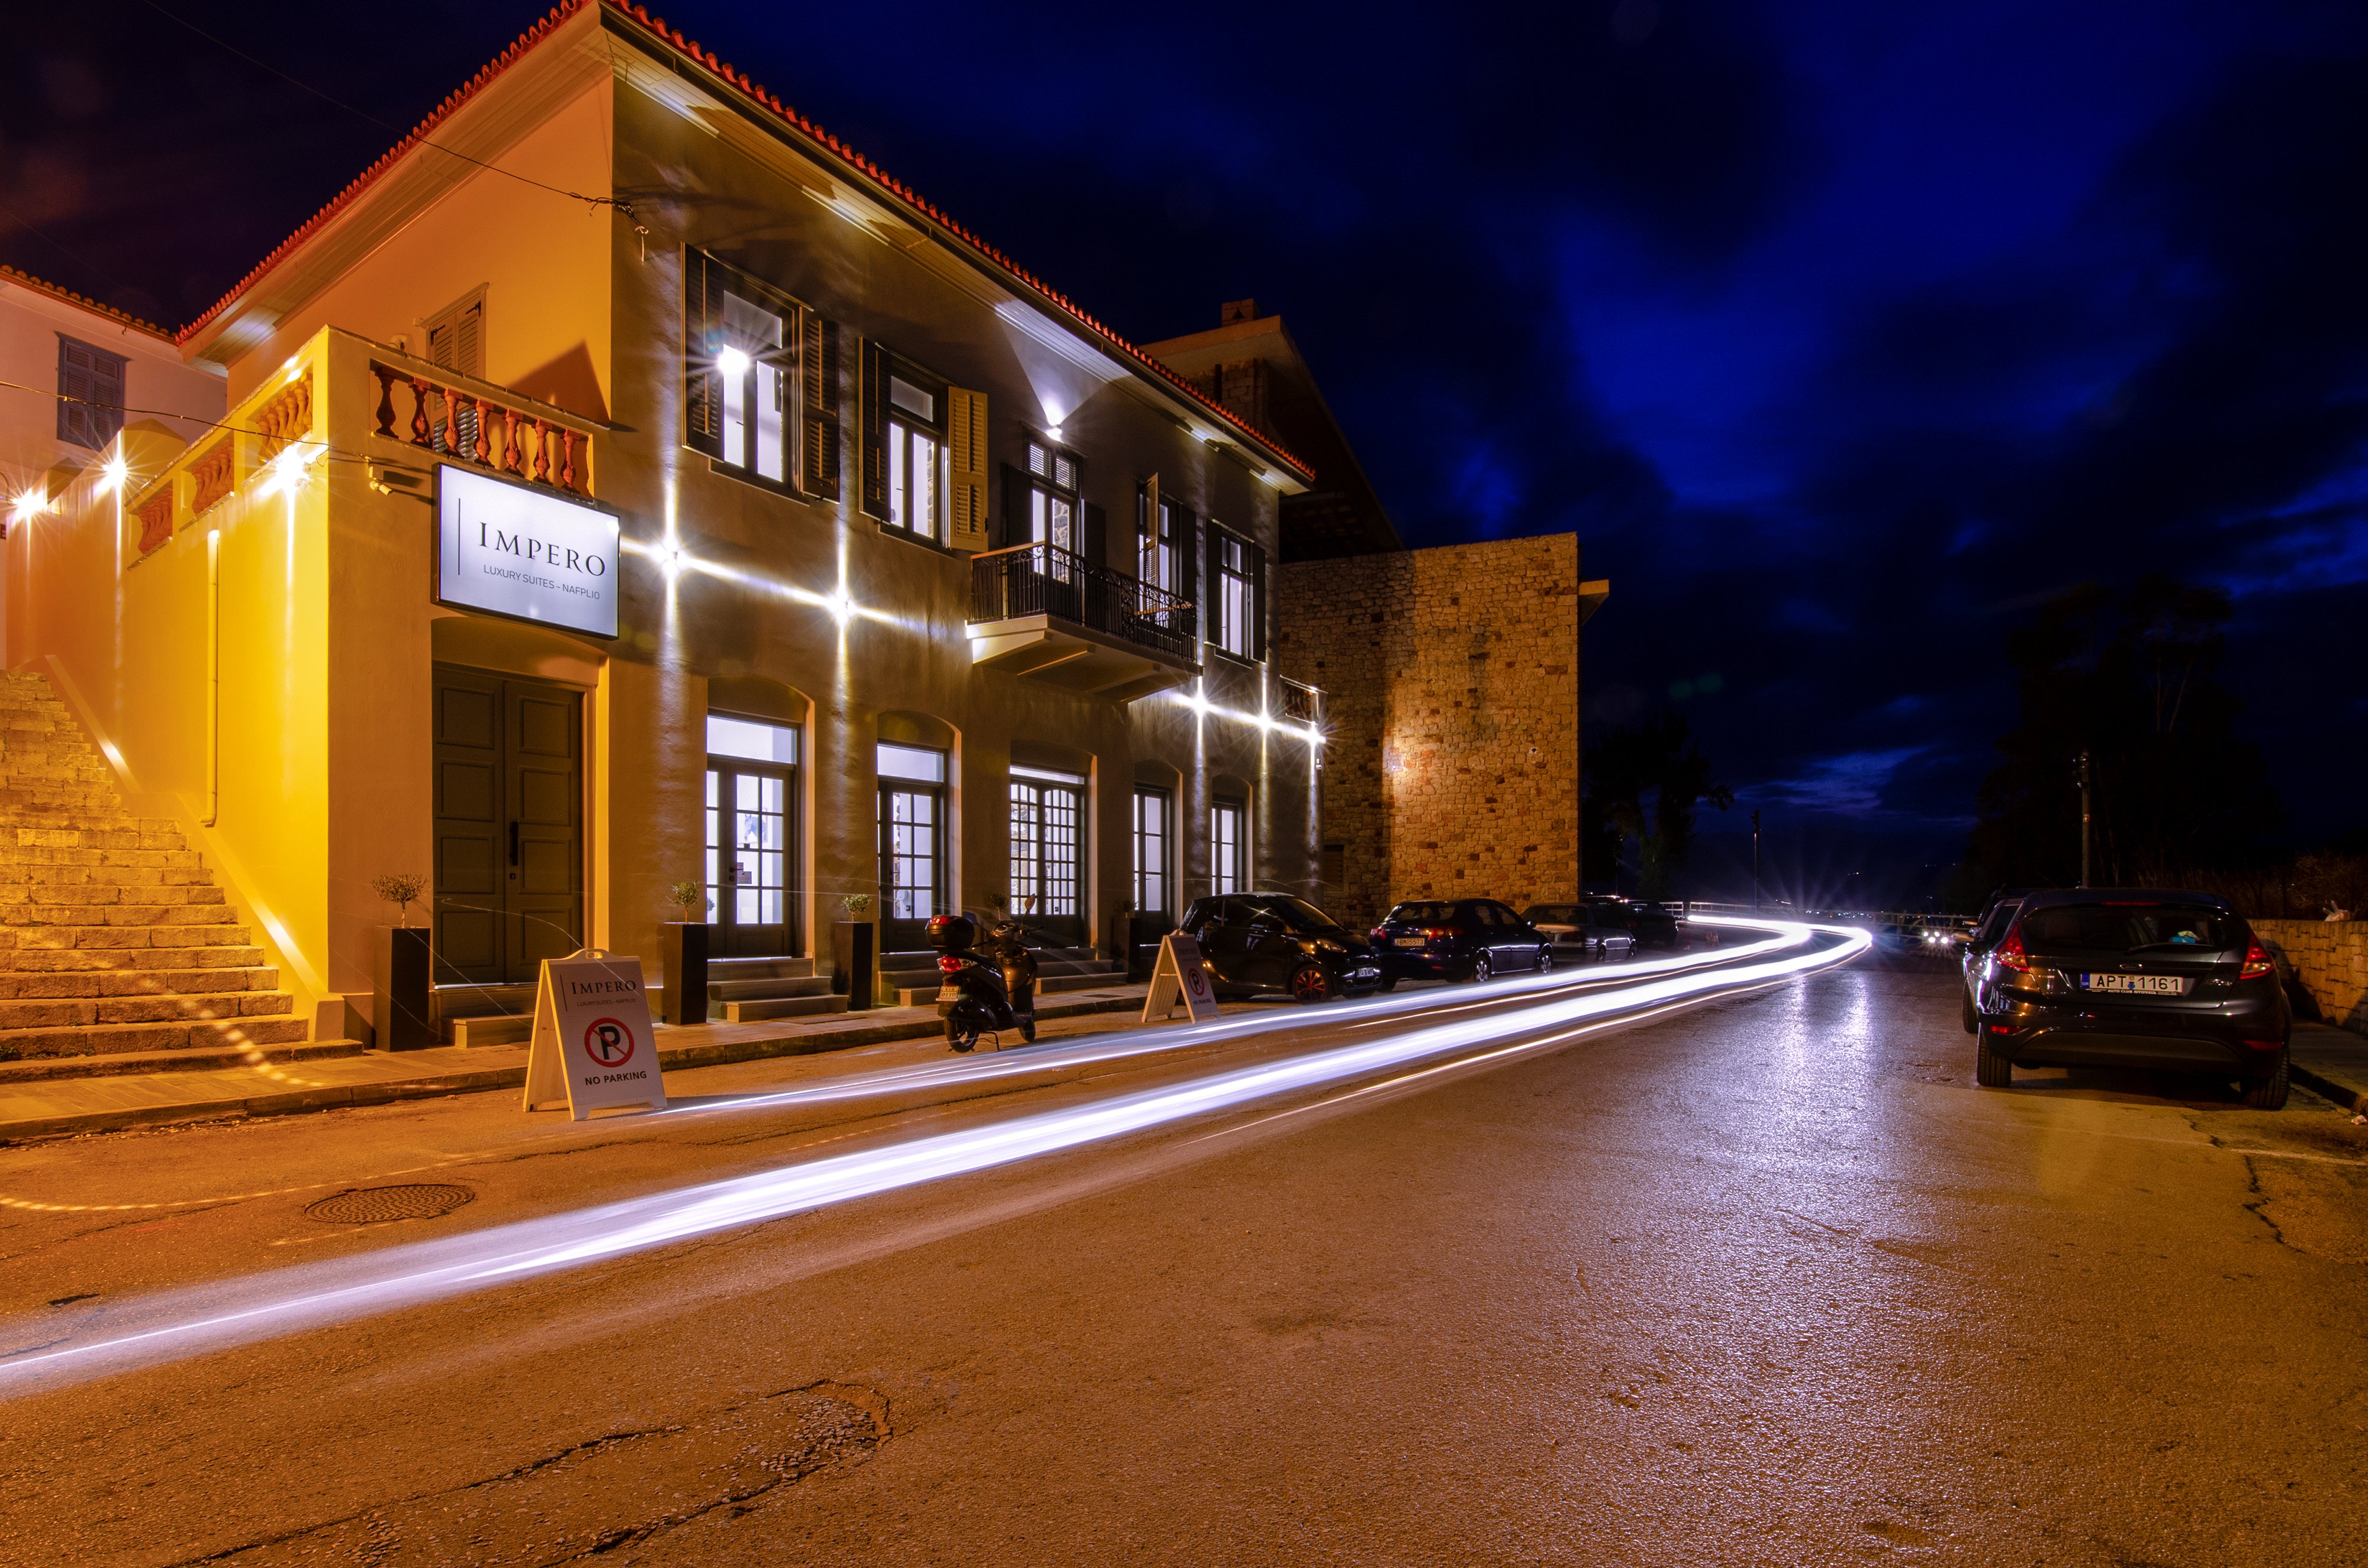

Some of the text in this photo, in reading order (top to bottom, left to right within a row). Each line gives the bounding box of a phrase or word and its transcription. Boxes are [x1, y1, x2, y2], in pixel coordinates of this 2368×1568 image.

[477, 521, 606, 577] IMPERO
[484, 564, 522, 581] LUXURY
[523, 574, 555, 589] SUITES
[562, 584, 600, 600] NAFPLIO
[571, 980, 636, 994] IMPERO
[585, 1071, 647, 1086] NO PARKING
